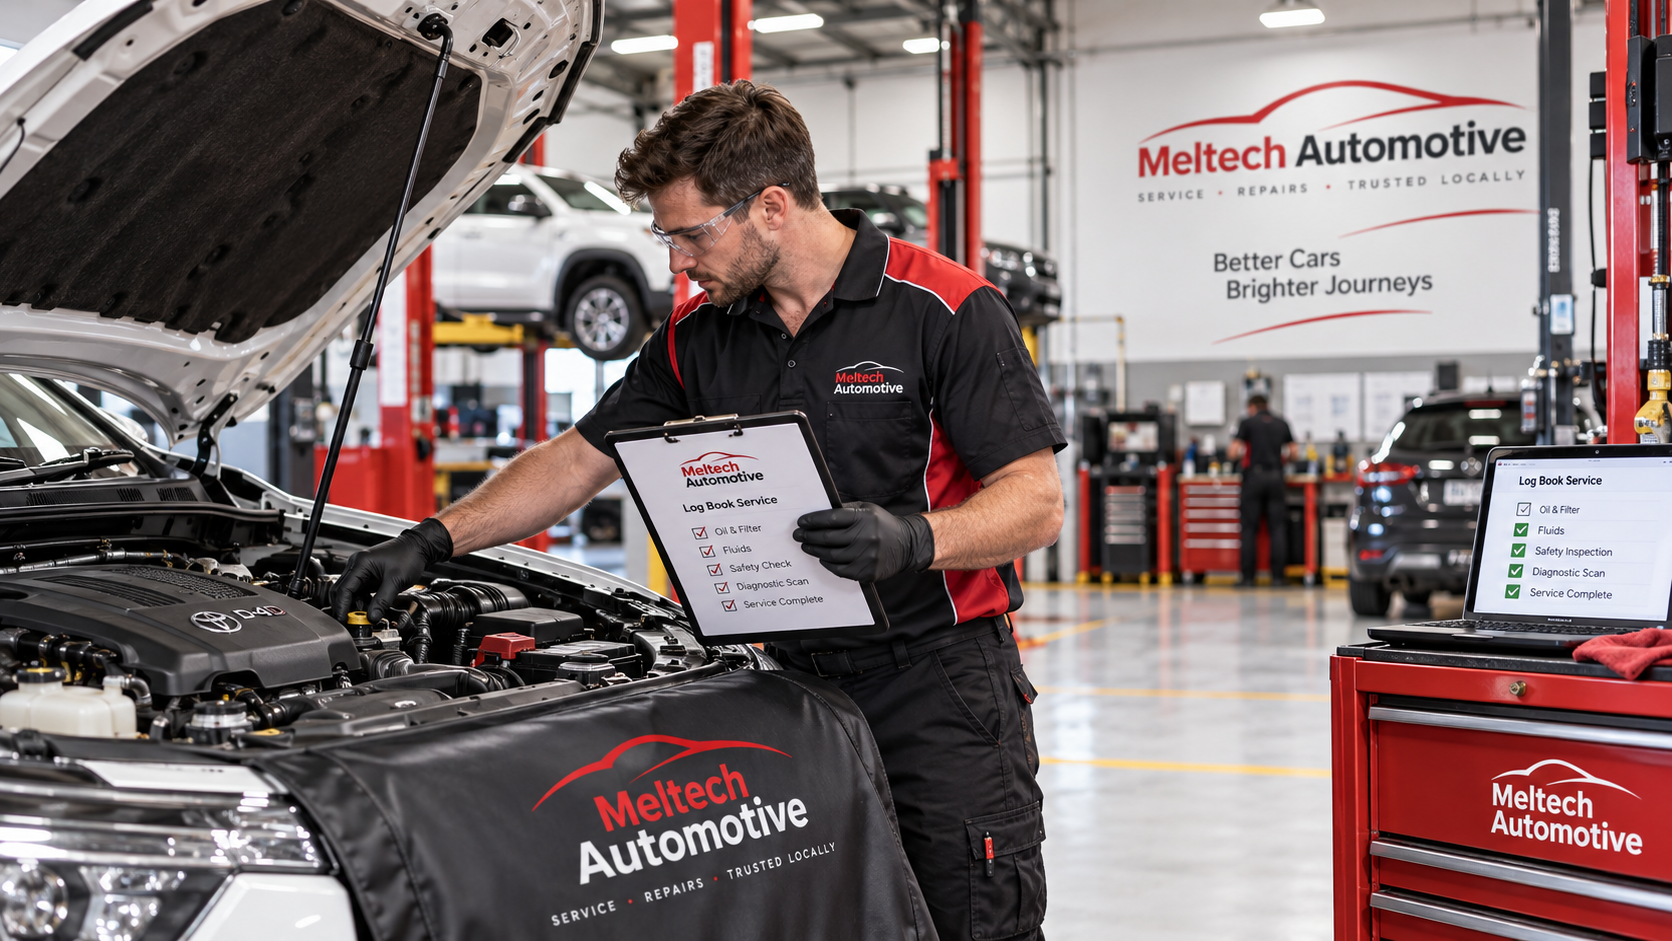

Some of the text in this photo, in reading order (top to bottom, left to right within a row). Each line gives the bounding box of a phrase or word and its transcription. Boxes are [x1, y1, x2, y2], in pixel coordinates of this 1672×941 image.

[1138, 120, 1527, 178] Meltech Automotive
[1138, 169, 1525, 203] SERVICE REPAIRS TRUSTED LOCALLY
[1214, 248, 1341, 272] Better Cars
[1227, 274, 1433, 304] Brighter Journeys
[835, 371, 884, 383] Meltech
[833, 382, 904, 394] Automotive
[681, 461, 740, 477] Meltech
[686, 471, 764, 488] Automotive
[1519, 476, 1602, 488] Log Book Service
[682, 496, 778, 513] Log Book Service
[1539, 505, 1580, 514] Oil & Filter
[714, 524, 762, 536] Oil & Filter
[1537, 526, 1565, 535] Fluids
[722, 544, 752, 554] Fluids
[1535, 546, 1613, 558] Safety Inspection
[729, 560, 792, 573] Safety Check
[1532, 567, 1606, 578] Diagnostic Scan
[736, 577, 809, 591] Diagnostic Scan
[1529, 588, 1613, 600] Service Complete
[743, 595, 824, 609] Service Complete
[593, 763, 750, 832] Meltech
[1492, 782, 1594, 819] Meltech
[1490, 810, 1643, 855] Automotive
[579, 796, 809, 885] Automotive
[551, 842, 836, 926] SERVICE REPAIRS TRUSTED LOCALLY
